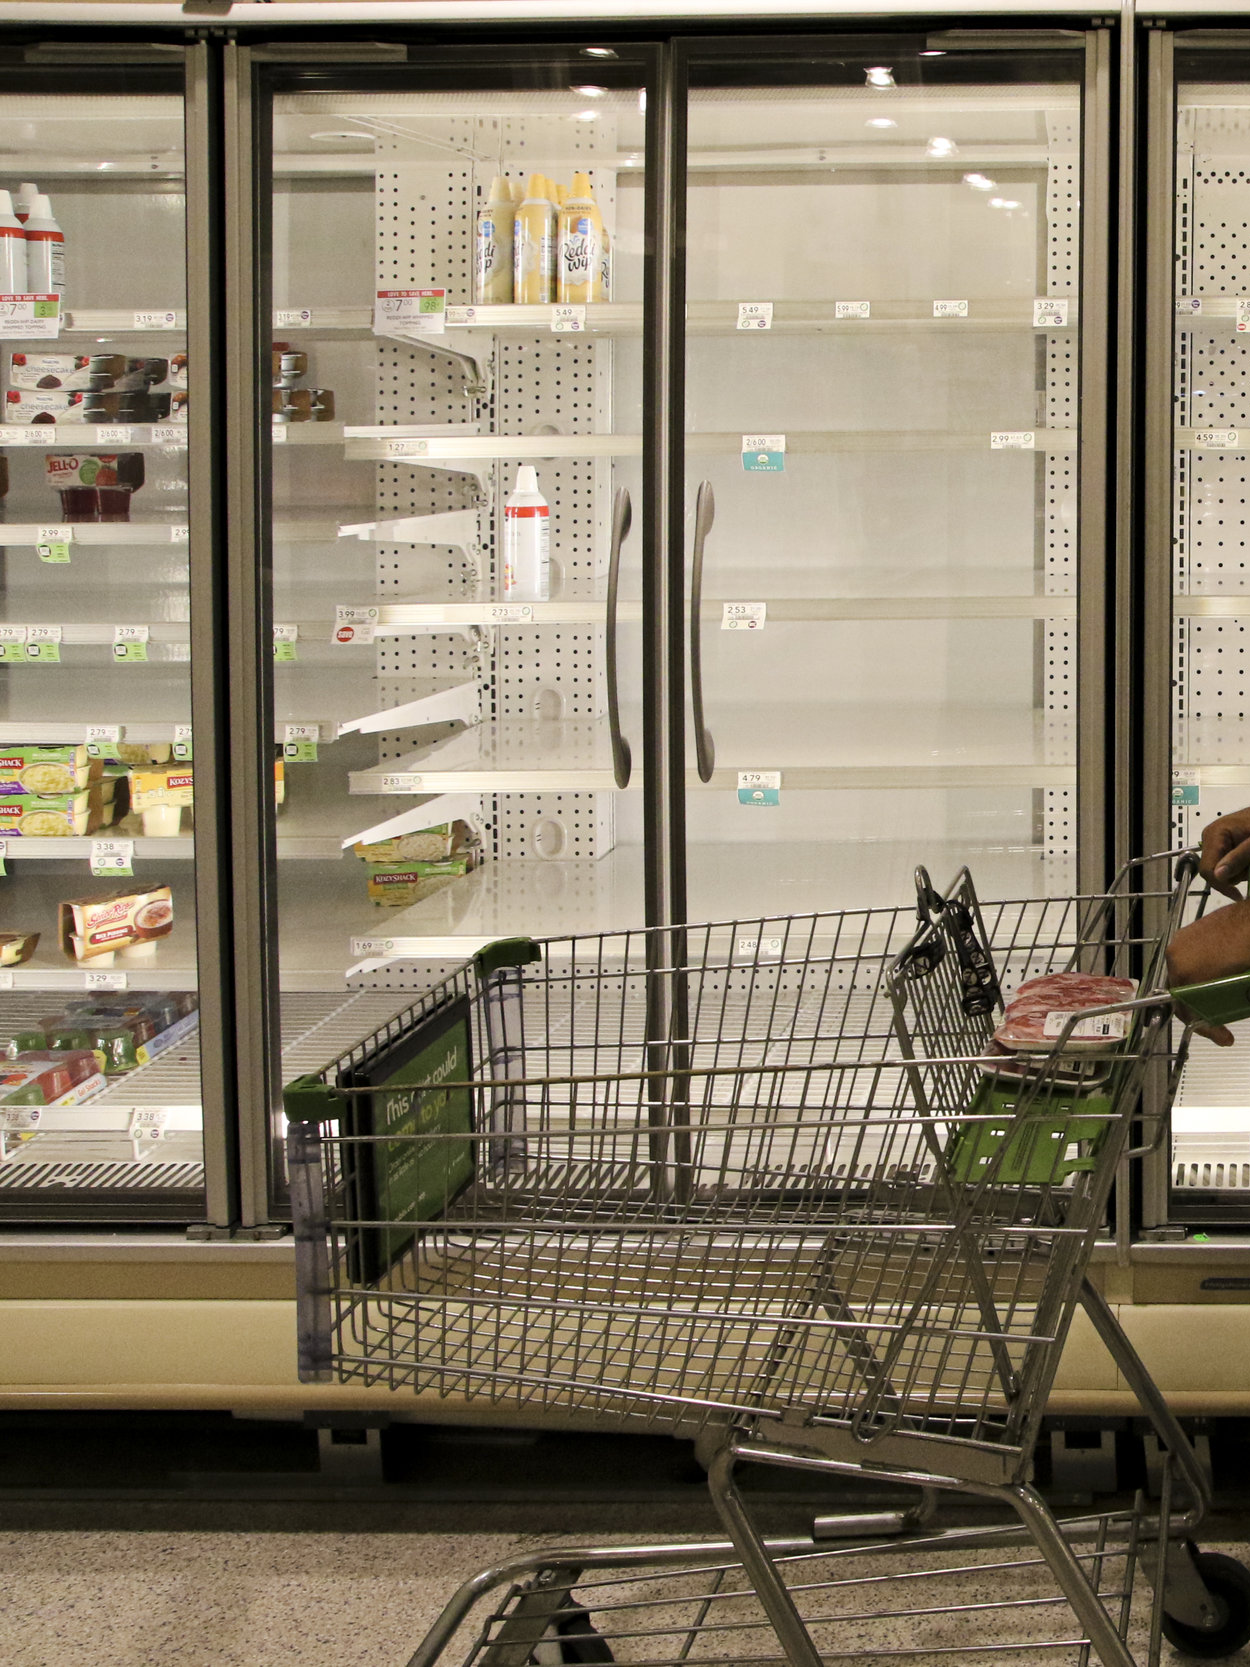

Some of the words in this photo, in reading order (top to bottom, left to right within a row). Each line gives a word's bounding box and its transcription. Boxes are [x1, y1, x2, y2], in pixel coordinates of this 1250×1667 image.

[25, 366, 75, 374] cheesecake
[20, 402, 69, 411] cheesecake
[386, 1094, 410, 1126] This
[433, 1045, 457, 1085] could
